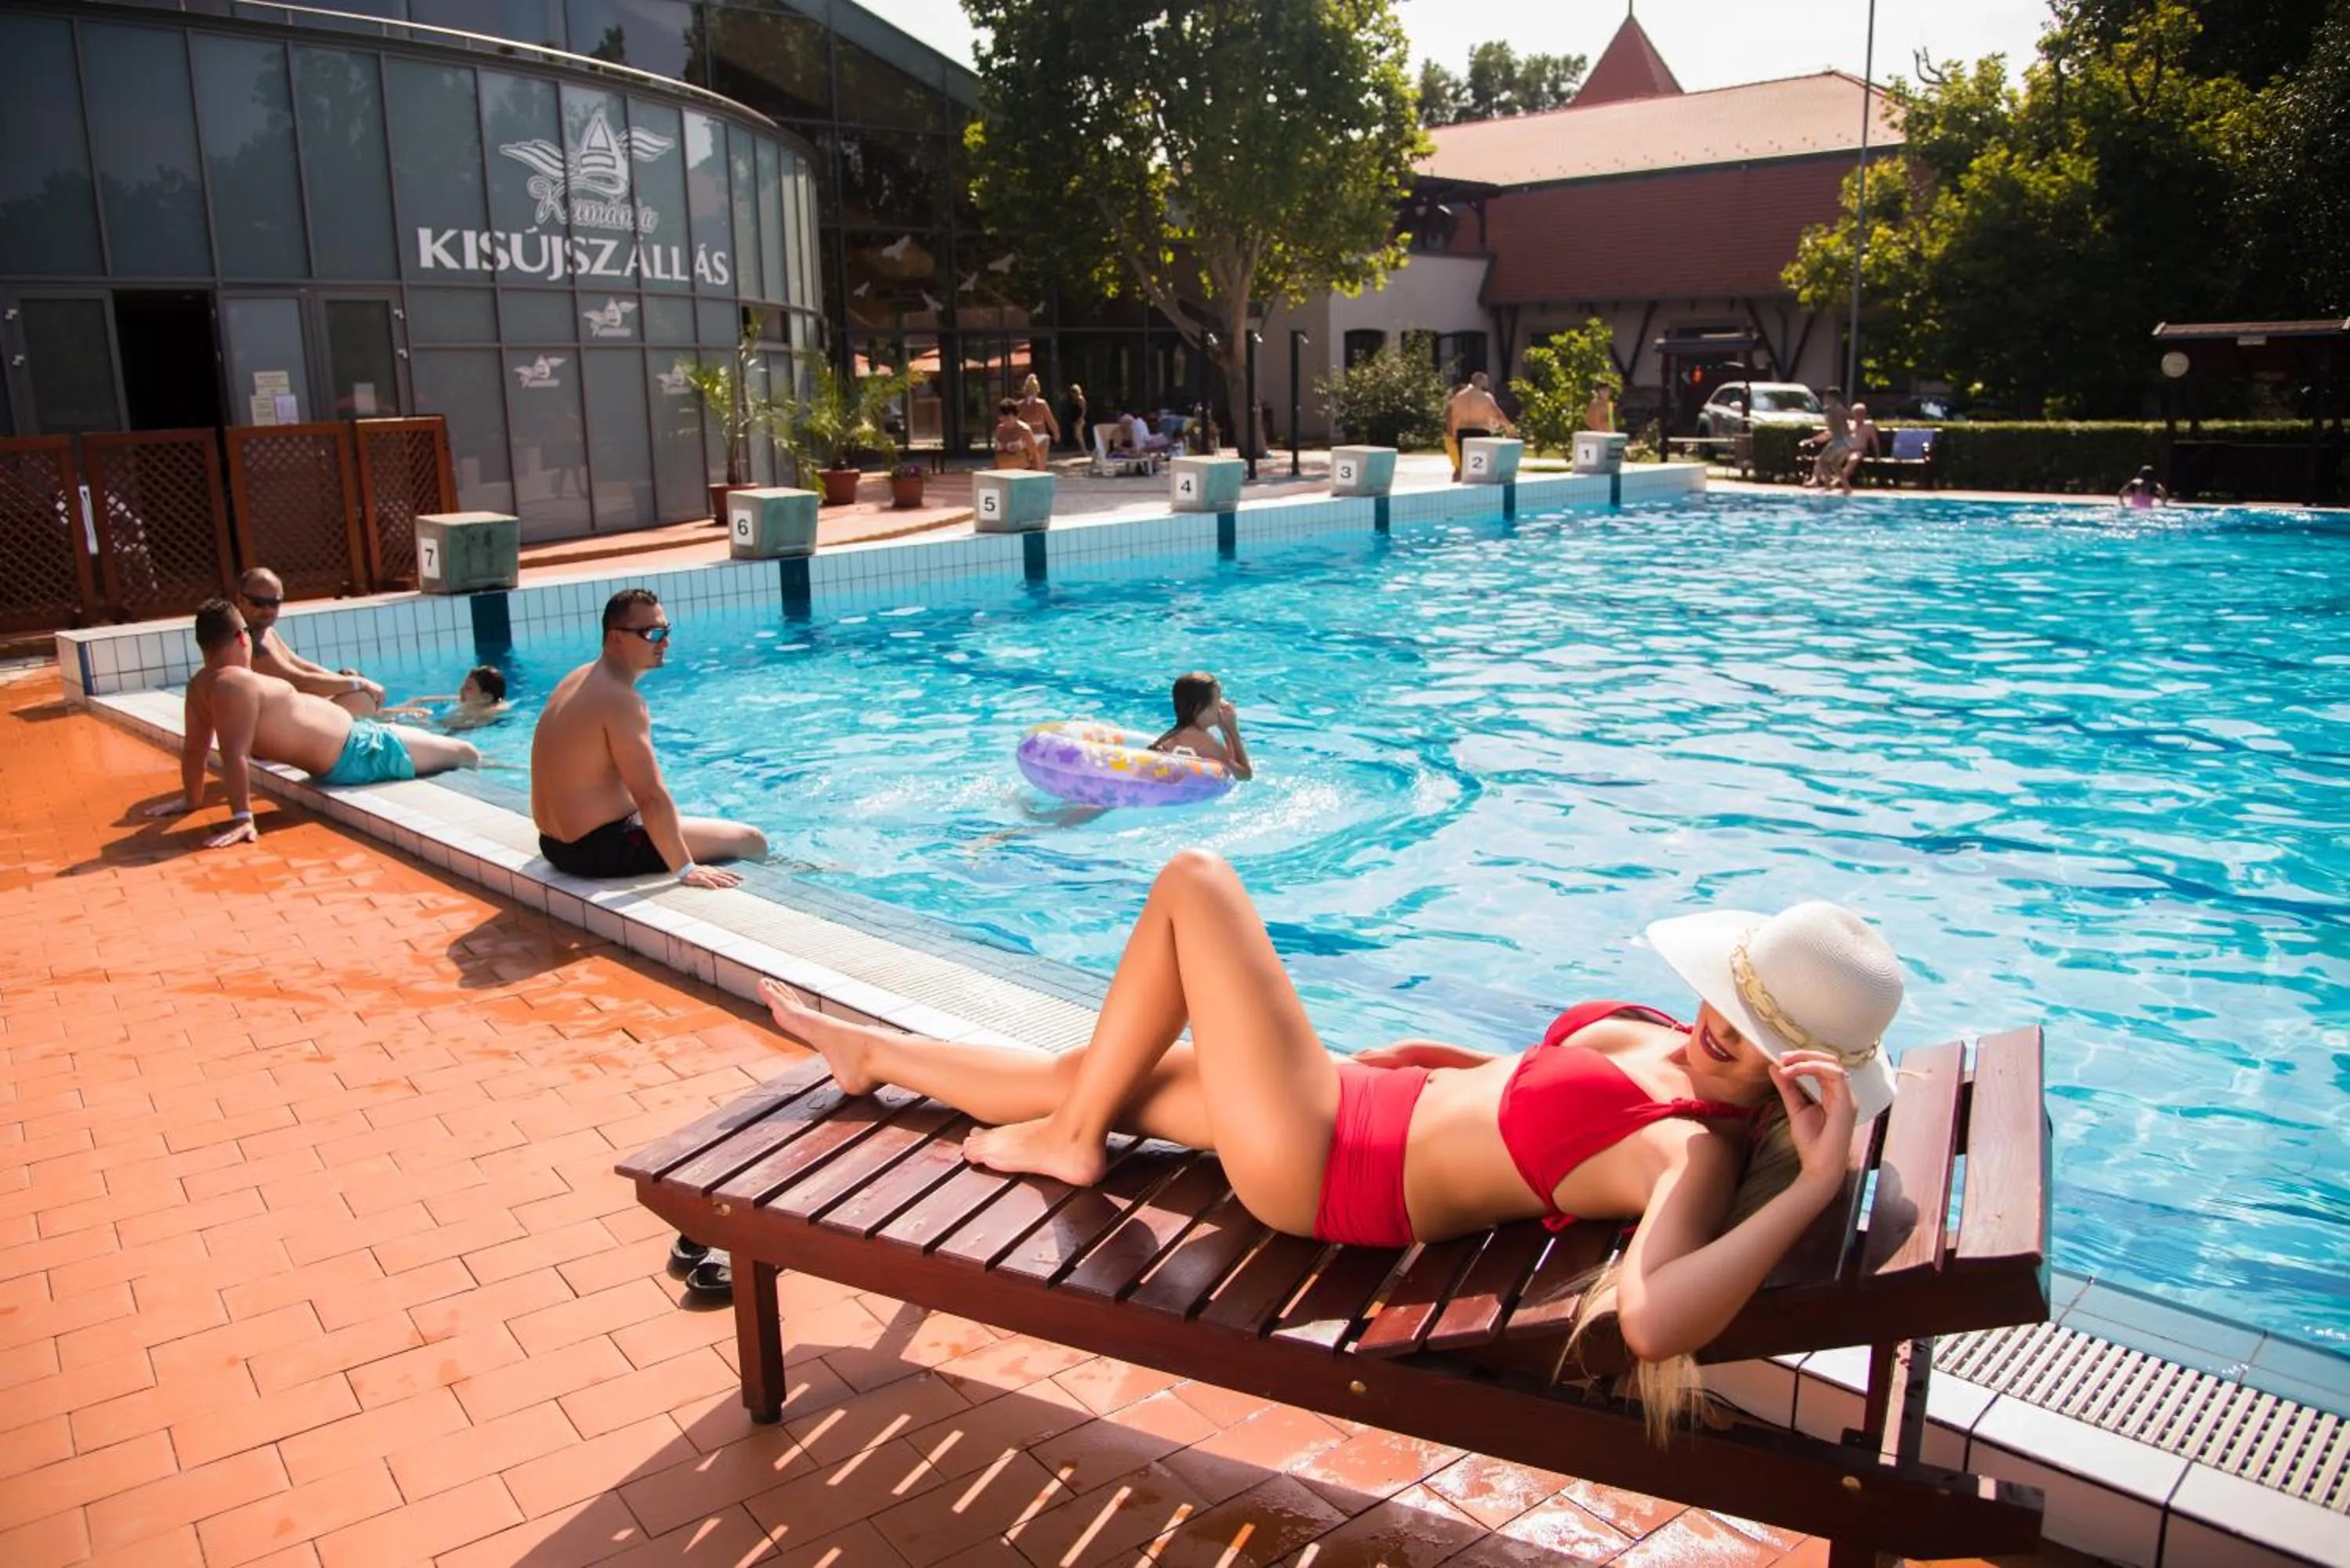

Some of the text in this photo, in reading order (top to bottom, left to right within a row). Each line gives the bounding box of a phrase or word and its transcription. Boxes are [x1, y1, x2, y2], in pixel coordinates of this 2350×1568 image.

[528, 175, 658, 233] Kumána
[417, 226, 730, 286] KISÚJSZÁLLÁS
[1472, 456, 1484, 469] 2
[1584, 449, 1590, 460] 1
[1340, 466, 1352, 479] 3
[1180, 479, 1191, 493] 4
[984, 496, 996, 512] 5
[737, 518, 749, 537] 6
[425, 547, 434, 567] 7
